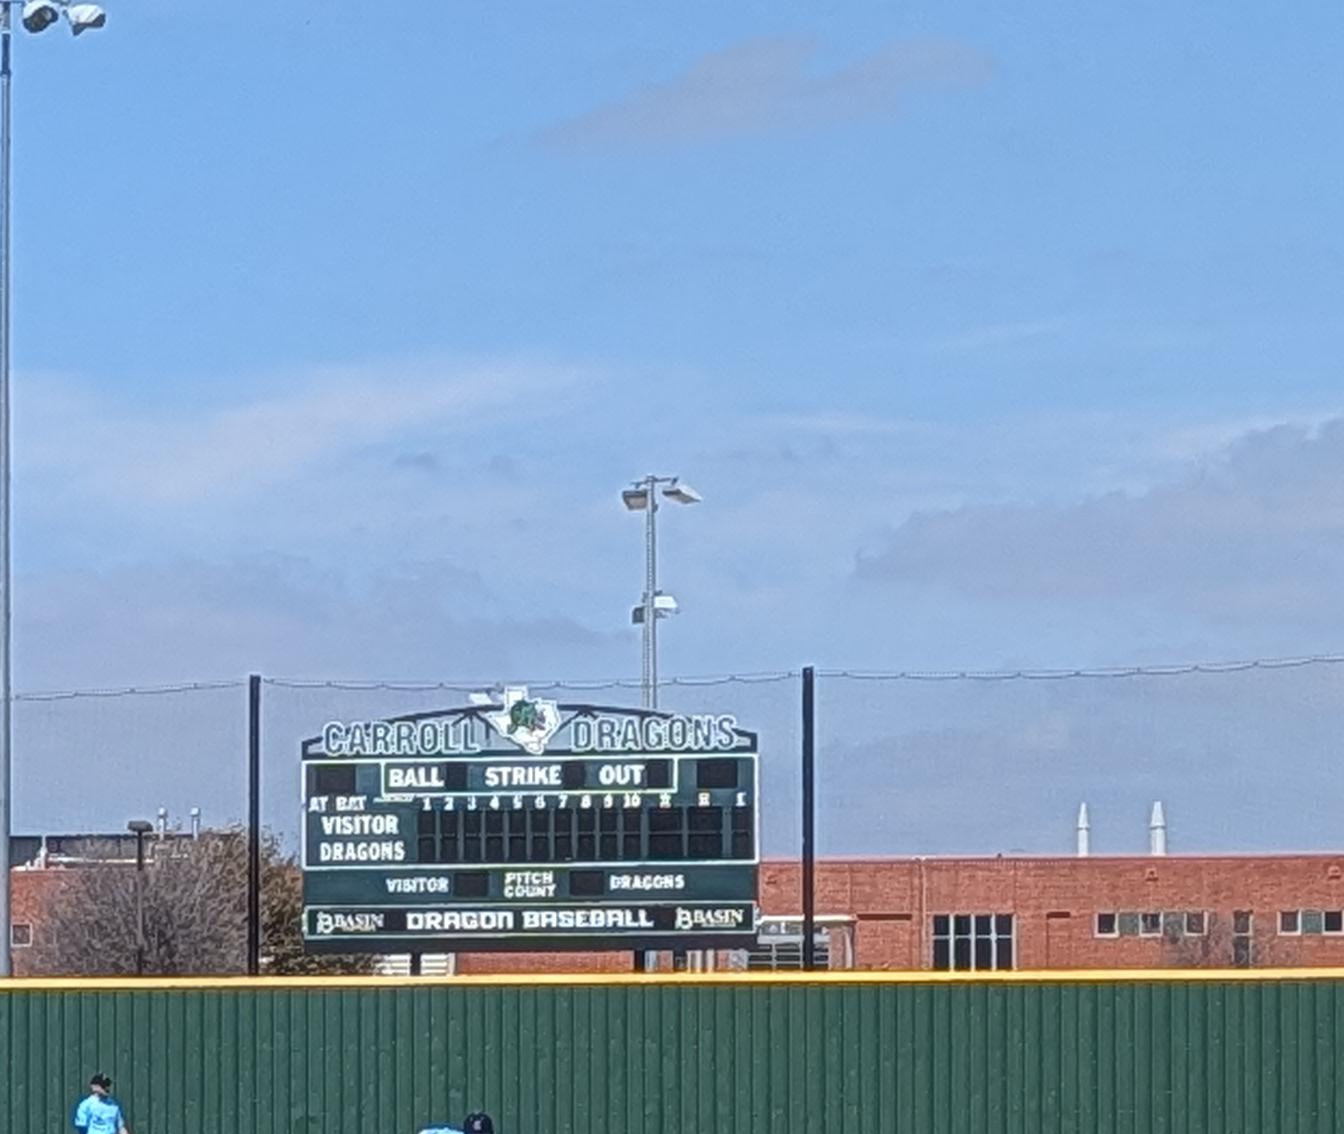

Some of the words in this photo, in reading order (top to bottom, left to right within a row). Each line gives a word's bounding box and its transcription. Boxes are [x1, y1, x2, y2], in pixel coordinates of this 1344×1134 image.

[322, 721, 481, 756] CARROLL
[570, 715, 739, 752] DRAGONS
[388, 767, 445, 787] BALL
[485, 765, 563, 787] STRIKE
[598, 764, 646, 786] OUT
[308, 796, 329, 812] AT
[335, 796, 368, 812] BAT
[422, 797, 433, 812] 1
[443, 797, 455, 812] 2
[466, 797, 477, 811] 3
[489, 797, 500, 811] 4
[512, 796, 523, 810] 5
[534, 796, 546, 810] 6
[558, 796, 568, 809] 7
[580, 795, 592, 809] 8
[603, 795, 614, 809] 9
[623, 795, 642, 808] 10
[321, 815, 400, 835] VISITOR
[319, 842, 406, 861] DRAGONS
[385, 877, 449, 893] VISITOR
[504, 871, 554, 885] PITCH
[609, 875, 686, 890] DRAGONS
[504, 884, 557, 898] COUNT
[334, 913, 385, 928] BASIN
[406, 911, 514, 930] DRAGON
[522, 909, 654, 929] BASEBALL
[693, 909, 745, 924] BASIN
